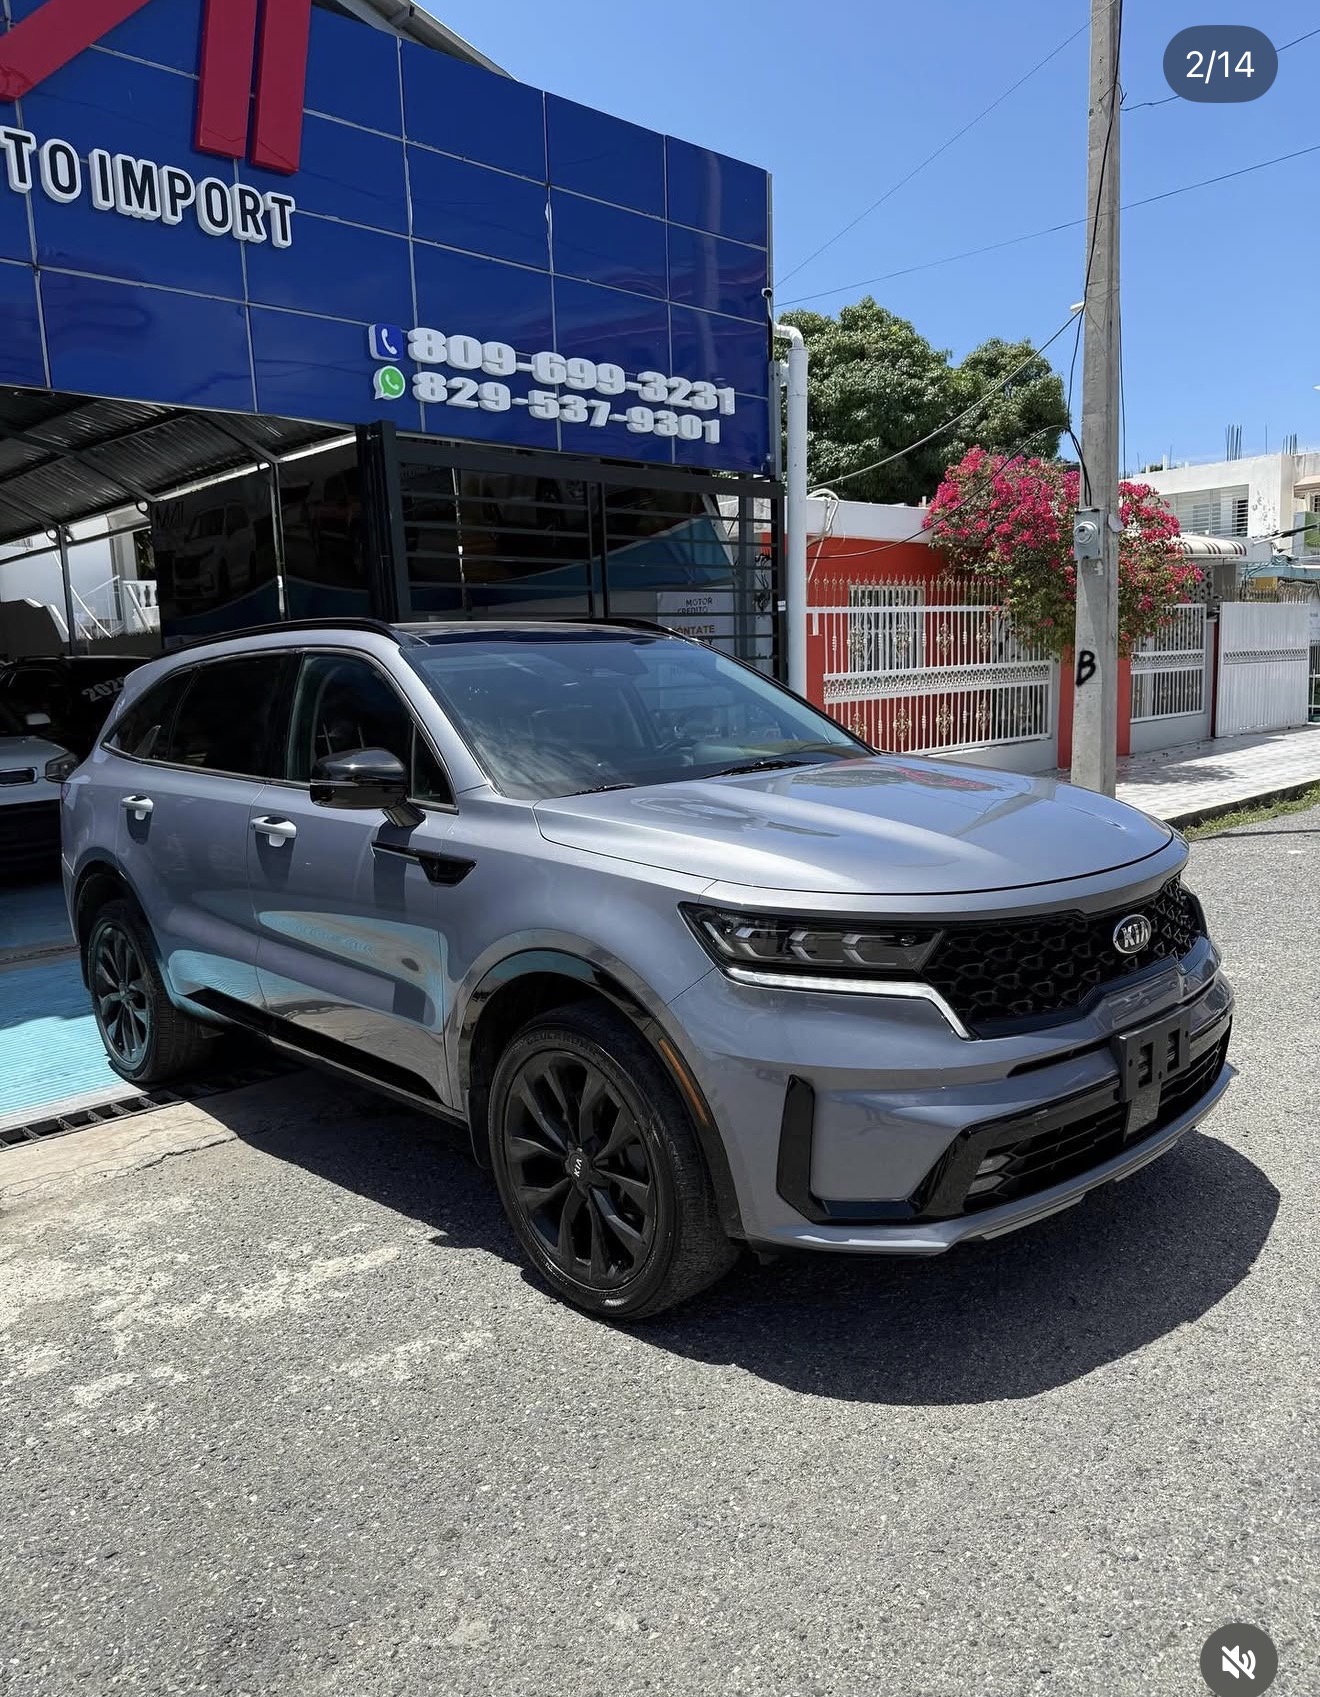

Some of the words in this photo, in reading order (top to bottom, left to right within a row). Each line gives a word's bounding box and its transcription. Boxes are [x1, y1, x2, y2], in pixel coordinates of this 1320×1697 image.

[88, 148, 295, 248] IMPORT
[408, 327, 736, 416] 809-699-3231
[412, 371, 720, 444] 829-537-9301
[1075, 650, 1096, 687] B
[1121, 921, 1149, 948] KIA
[573, 1158, 582, 1177] KIA
